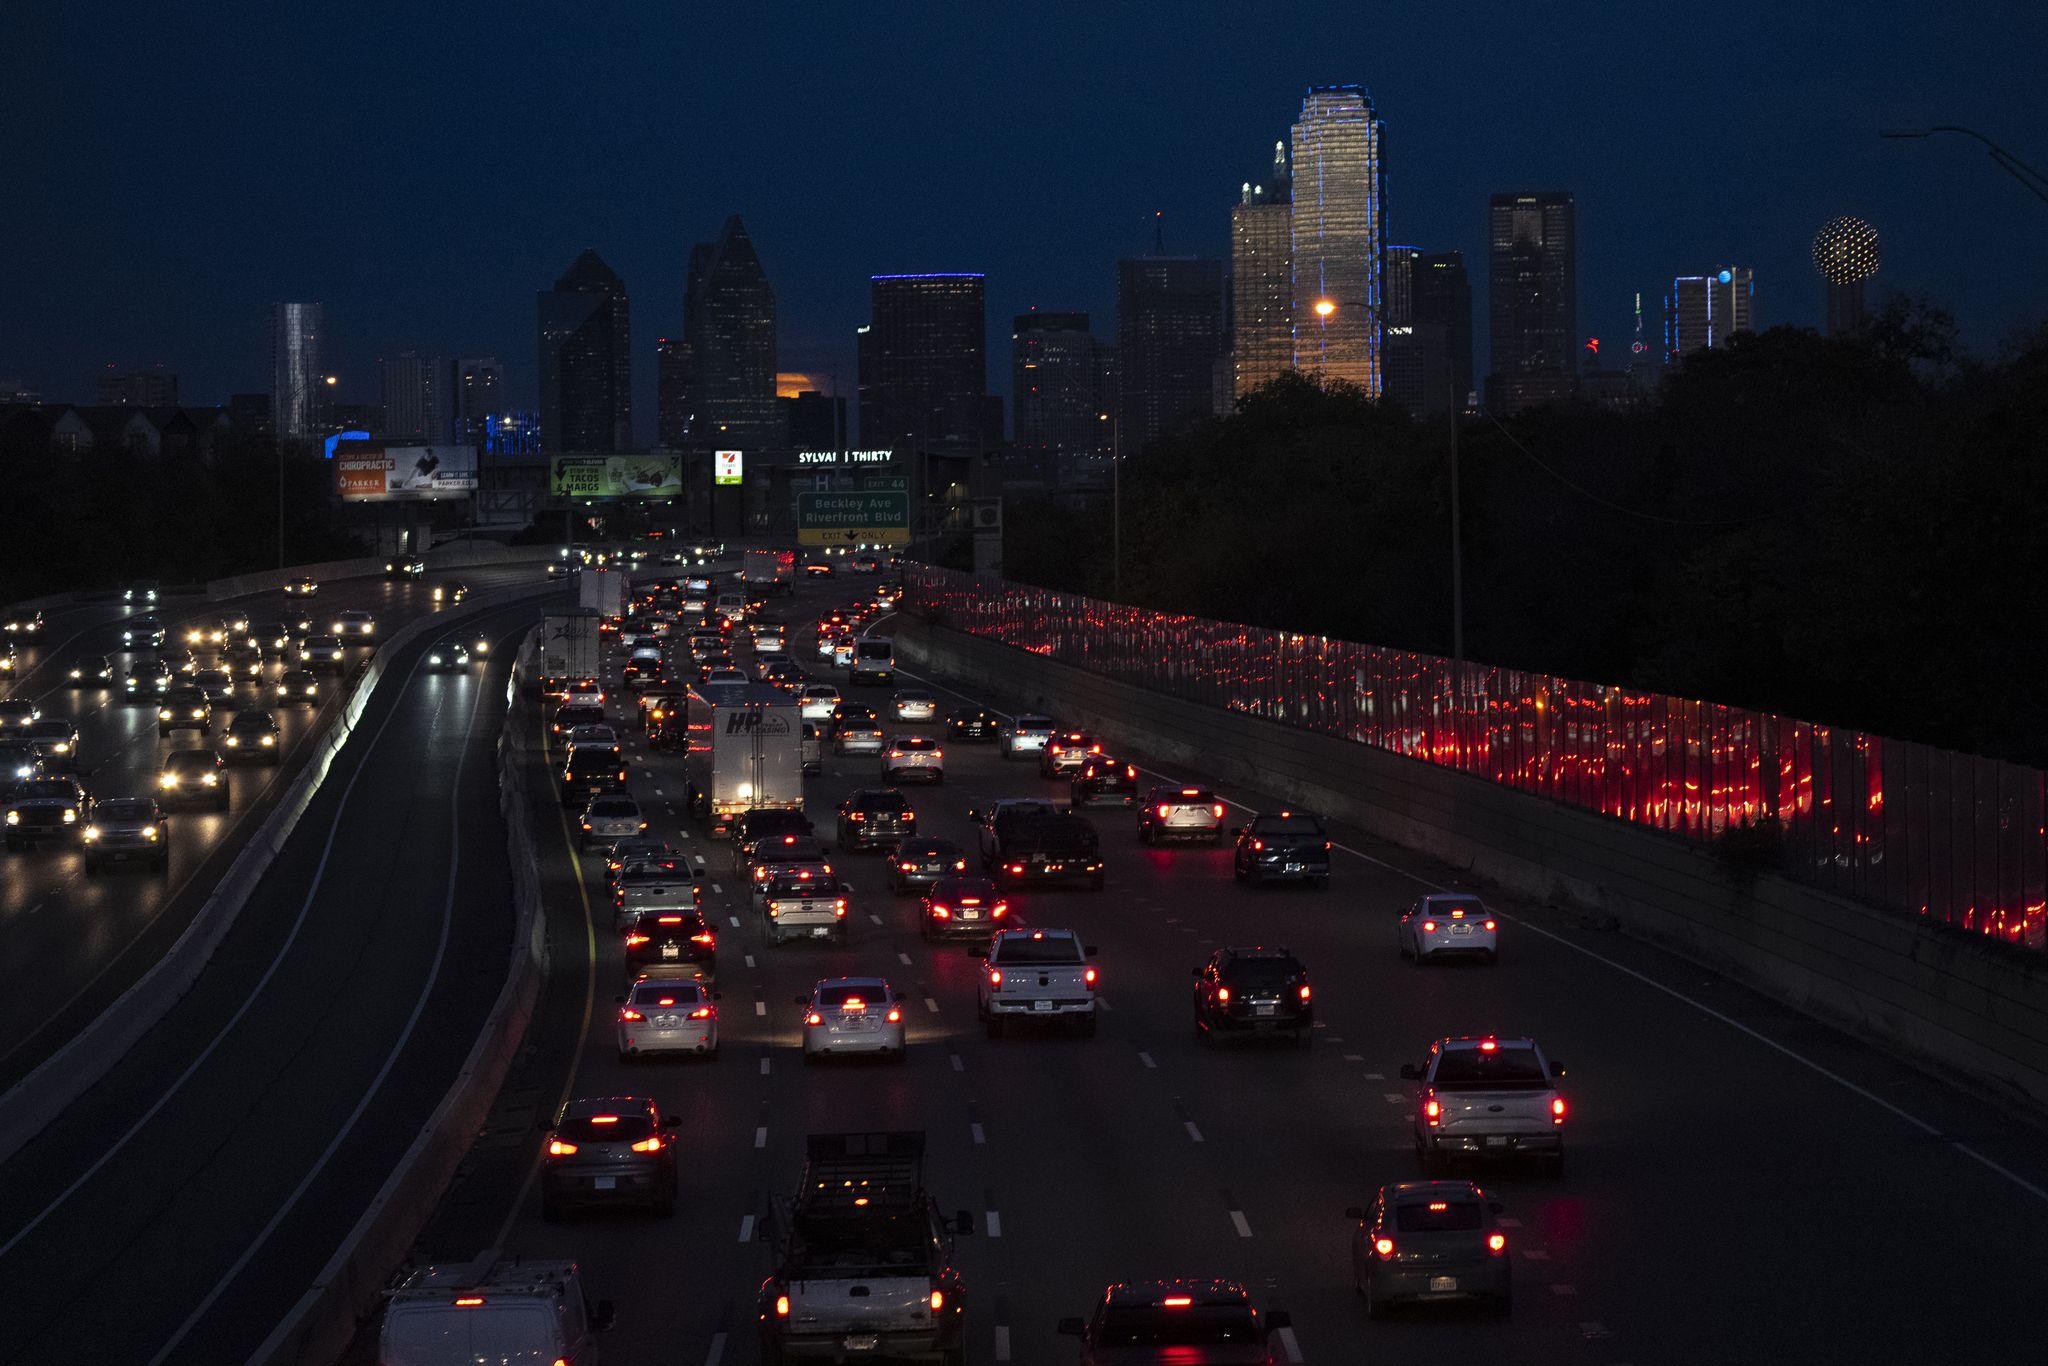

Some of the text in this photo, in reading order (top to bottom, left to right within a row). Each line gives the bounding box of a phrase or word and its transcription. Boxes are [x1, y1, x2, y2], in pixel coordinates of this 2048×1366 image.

[852, 450, 893, 462] THIRTY
[339, 459, 393, 471] CHIROPRACTIC
[570, 474, 599, 482] TACOS
[347, 479, 380, 487] PARKER
[566, 483, 599, 491] MARGS
[815, 498, 891, 510] Beckley Ave
[806, 511, 901, 522] Riverfront Blvd
[861, 531, 885, 539] ONLY
